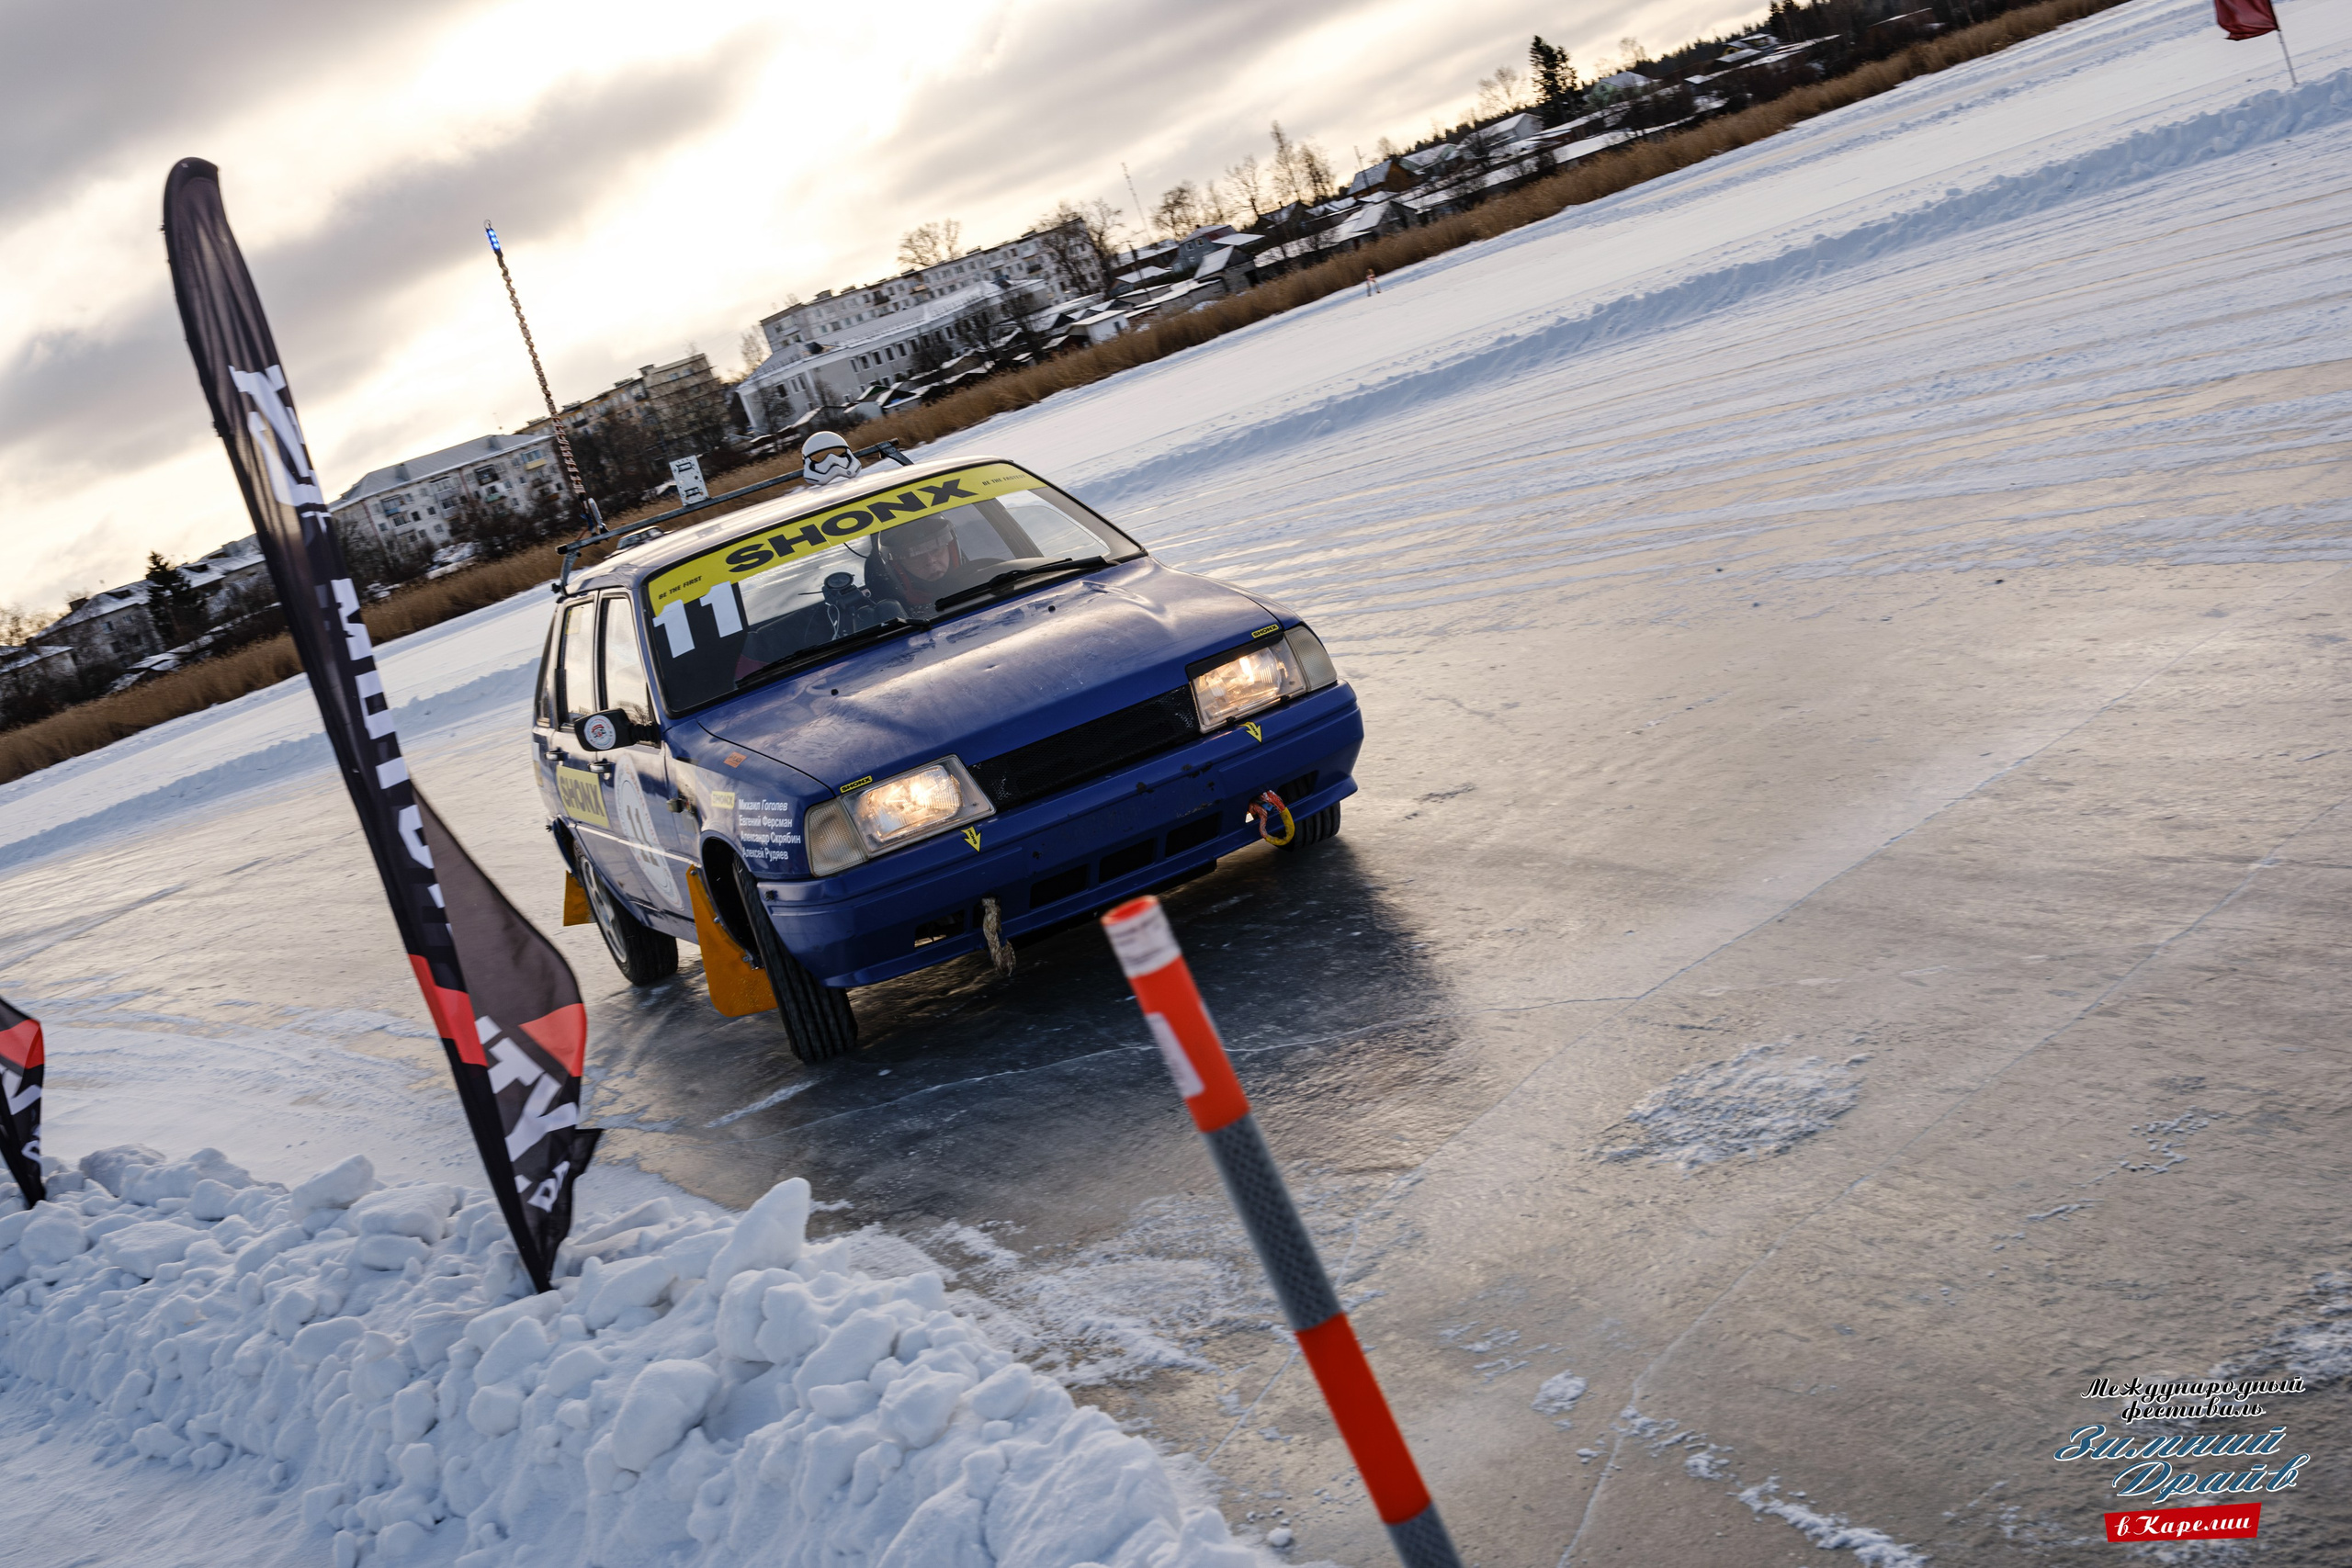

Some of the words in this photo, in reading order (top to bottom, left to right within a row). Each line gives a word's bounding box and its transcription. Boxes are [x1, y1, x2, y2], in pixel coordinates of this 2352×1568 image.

[725, 479, 979, 572] SHONX
[658, 591, 668, 600] BE
[669, 585, 682, 594] THE
[683, 576, 703, 588] FIRST
[651, 581, 743, 659] 11
[1252, 625, 1278, 637] SHONX
[842, 777, 871, 792] SHONX
[559, 775, 605, 818] SHONX
[738, 798, 761, 811] Михаил
[761, 799, 788, 811] Гоголев
[739, 815, 762, 827] Евгений
[762, 816, 793, 830] Ферсман
[627, 805, 660, 868] 11
[741, 830, 770, 845] Александр
[770, 831, 802, 847] Скрябин
[764, 847, 789, 863] Рудяев
